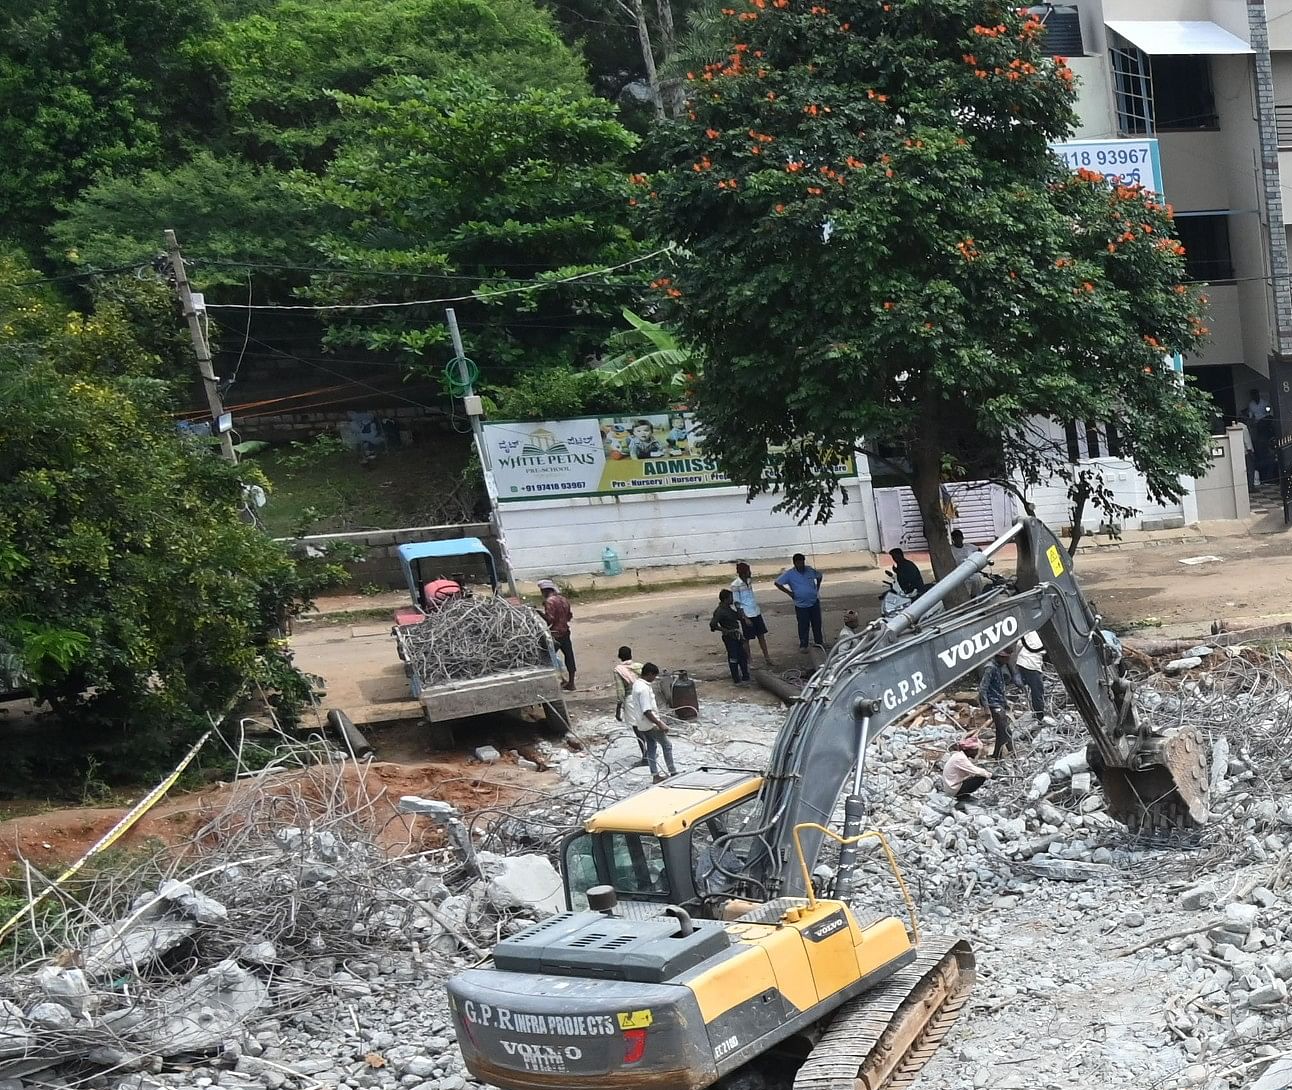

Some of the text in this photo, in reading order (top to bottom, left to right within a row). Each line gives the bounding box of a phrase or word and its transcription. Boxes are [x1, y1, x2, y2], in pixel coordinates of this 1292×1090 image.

[1060, 149, 1149, 166] 418 93967
[498, 453, 595, 469] WHITE PETALS
[644, 458, 719, 476] ADMISS
[525, 466, 572, 474] PRE-SCHOOL
[612, 480, 624, 488] Pre
[631, 478, 663, 487] Nursery
[671, 476, 702, 484] Nursery
[883, 615, 1018, 710] G.P.R VOLVO
[814, 919, 843, 937] VOLVO
[513, 1013, 548, 1035] INFRA
